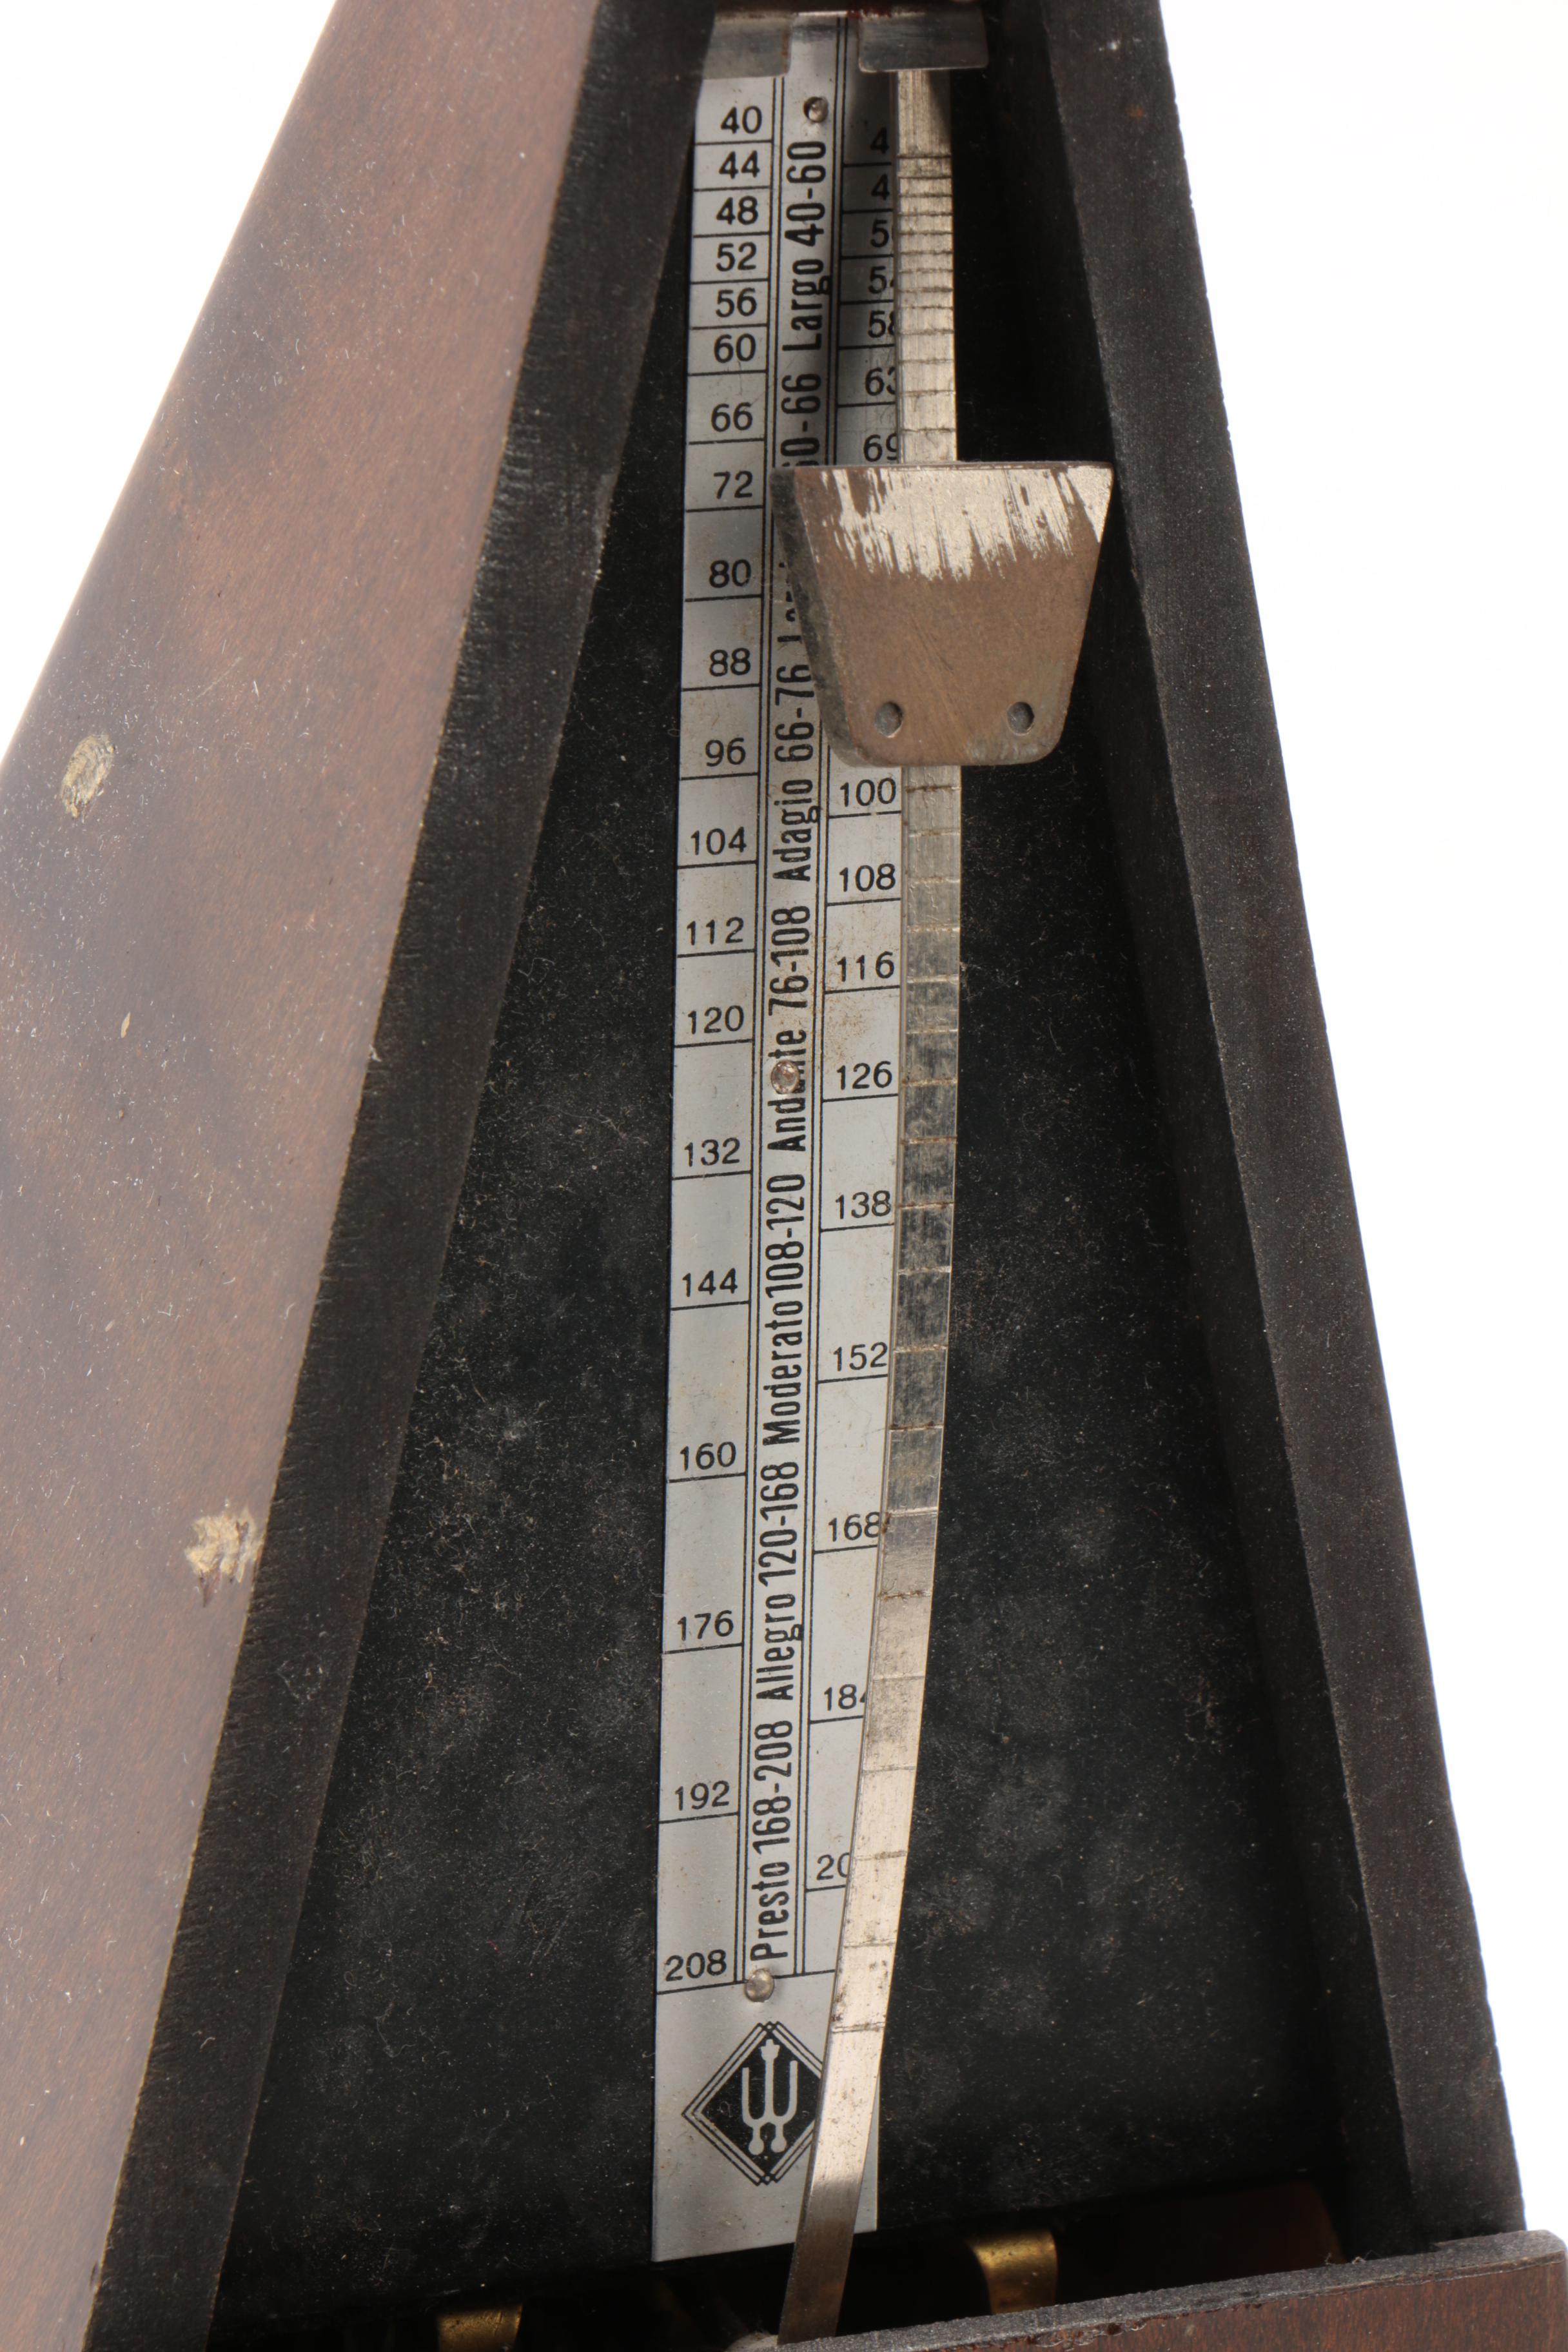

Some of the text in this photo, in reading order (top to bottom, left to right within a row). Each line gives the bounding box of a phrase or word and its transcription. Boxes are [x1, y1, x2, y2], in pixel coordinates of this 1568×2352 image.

[721, 106, 762, 133] 40
[719, 151, 760, 179] 44
[716, 196, 758, 224] 48
[716, 242, 756, 271] 52
[782, 141, 830, 351] Largo 40-60
[868, 266, 894, 294] 5
[716, 288, 757, 317] 56
[714, 333, 756, 363] 60
[711, 402, 752, 431] 66
[780, 373, 821, 467] 0-66
[713, 471, 753, 499] 72
[709, 559, 751, 588] 80
[709, 648, 750, 676] 88
[774, 664, 814, 762] 66-76
[705, 738, 746, 767] 96
[839, 778, 896, 807] 100
[691, 827, 747, 856] 104
[774, 778, 821, 881] Adagio
[839, 863, 896, 892] 108
[687, 917, 743, 945] 112
[769, 905, 810, 1016] 76-108
[838, 951, 895, 982] 116
[687, 1005, 743, 1034] 120
[837, 1061, 893, 1090] 126
[684, 1137, 740, 1167] 132
[836, 1190, 892, 1219] 138
[682, 1268, 738, 1297] 144
[763, 1174, 805, 1446] Moderato 108-120
[833, 1342, 888, 1371] 152
[680, 1442, 736, 1471] 160
[828, 1511, 880, 1542] 168
[756, 1461, 804, 1700] Allegro 120-168
[678, 1610, 734, 1640] 176
[675, 1781, 729, 1810] 192
[750, 1720, 793, 1961] Presto 168-208
[665, 1950, 727, 1981] 208
